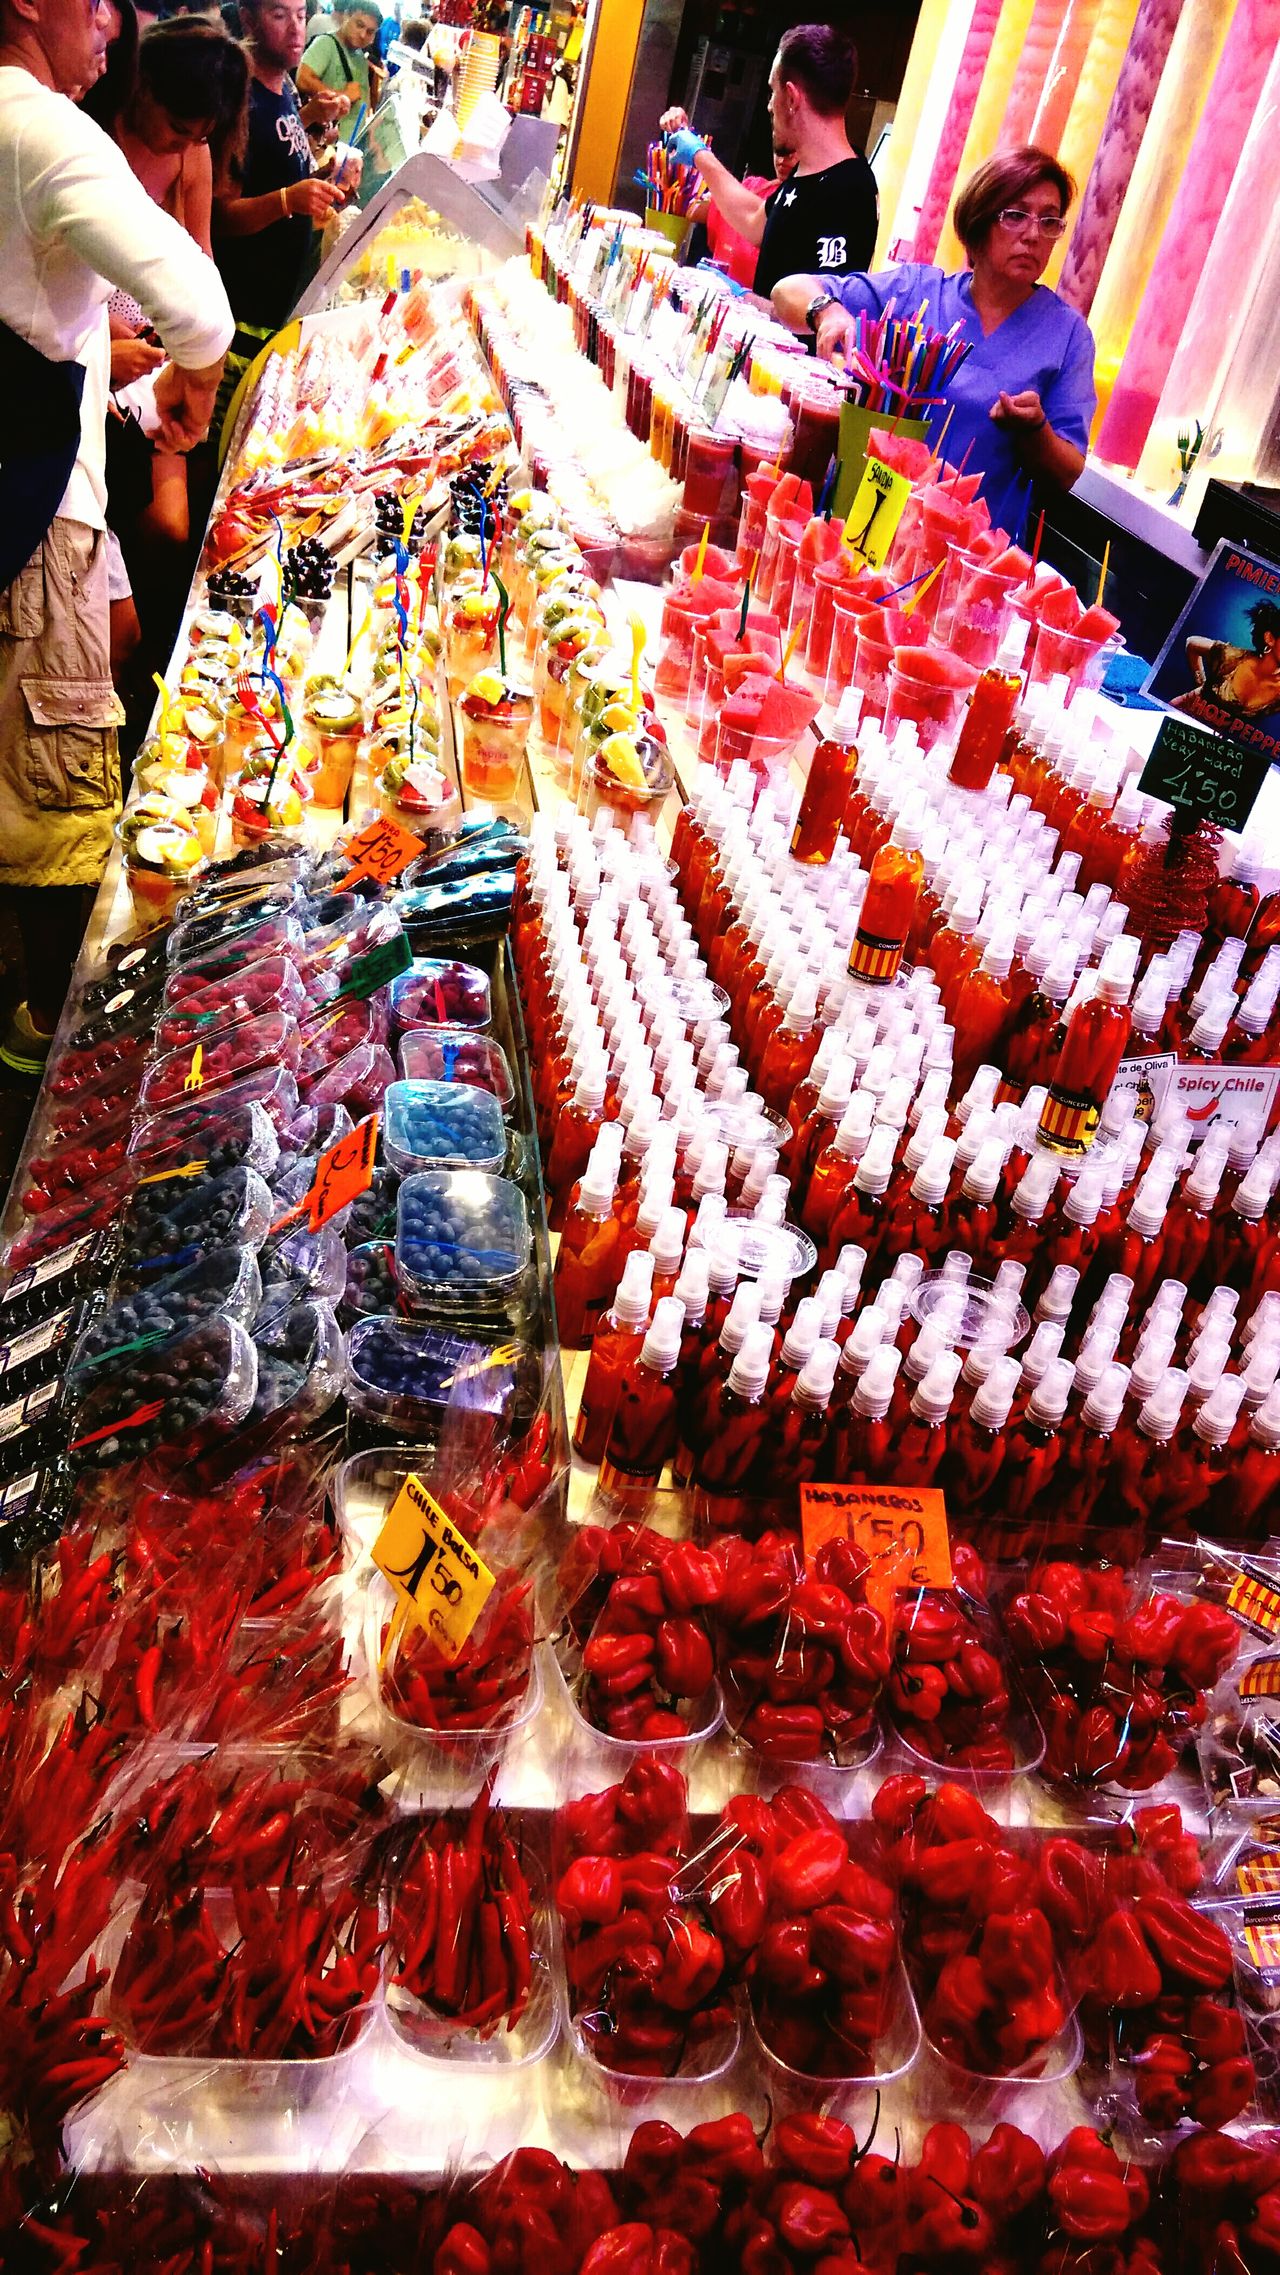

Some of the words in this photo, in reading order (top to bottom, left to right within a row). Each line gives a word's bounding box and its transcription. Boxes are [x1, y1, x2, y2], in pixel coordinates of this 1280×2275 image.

[816, 236, 847, 268] B
[846, 488, 887, 557] 1
[1225, 553, 1280, 596] PIMIE
[1192, 696, 1231, 727] HOT
[1130, 1063, 1142, 1073] de
[1144, 1060, 1169, 1071] Oliva
[1177, 1076, 1221, 1092] Spicy
[1224, 1077, 1265, 1092] Chile
[406, 1483, 440, 1528] CHILE
